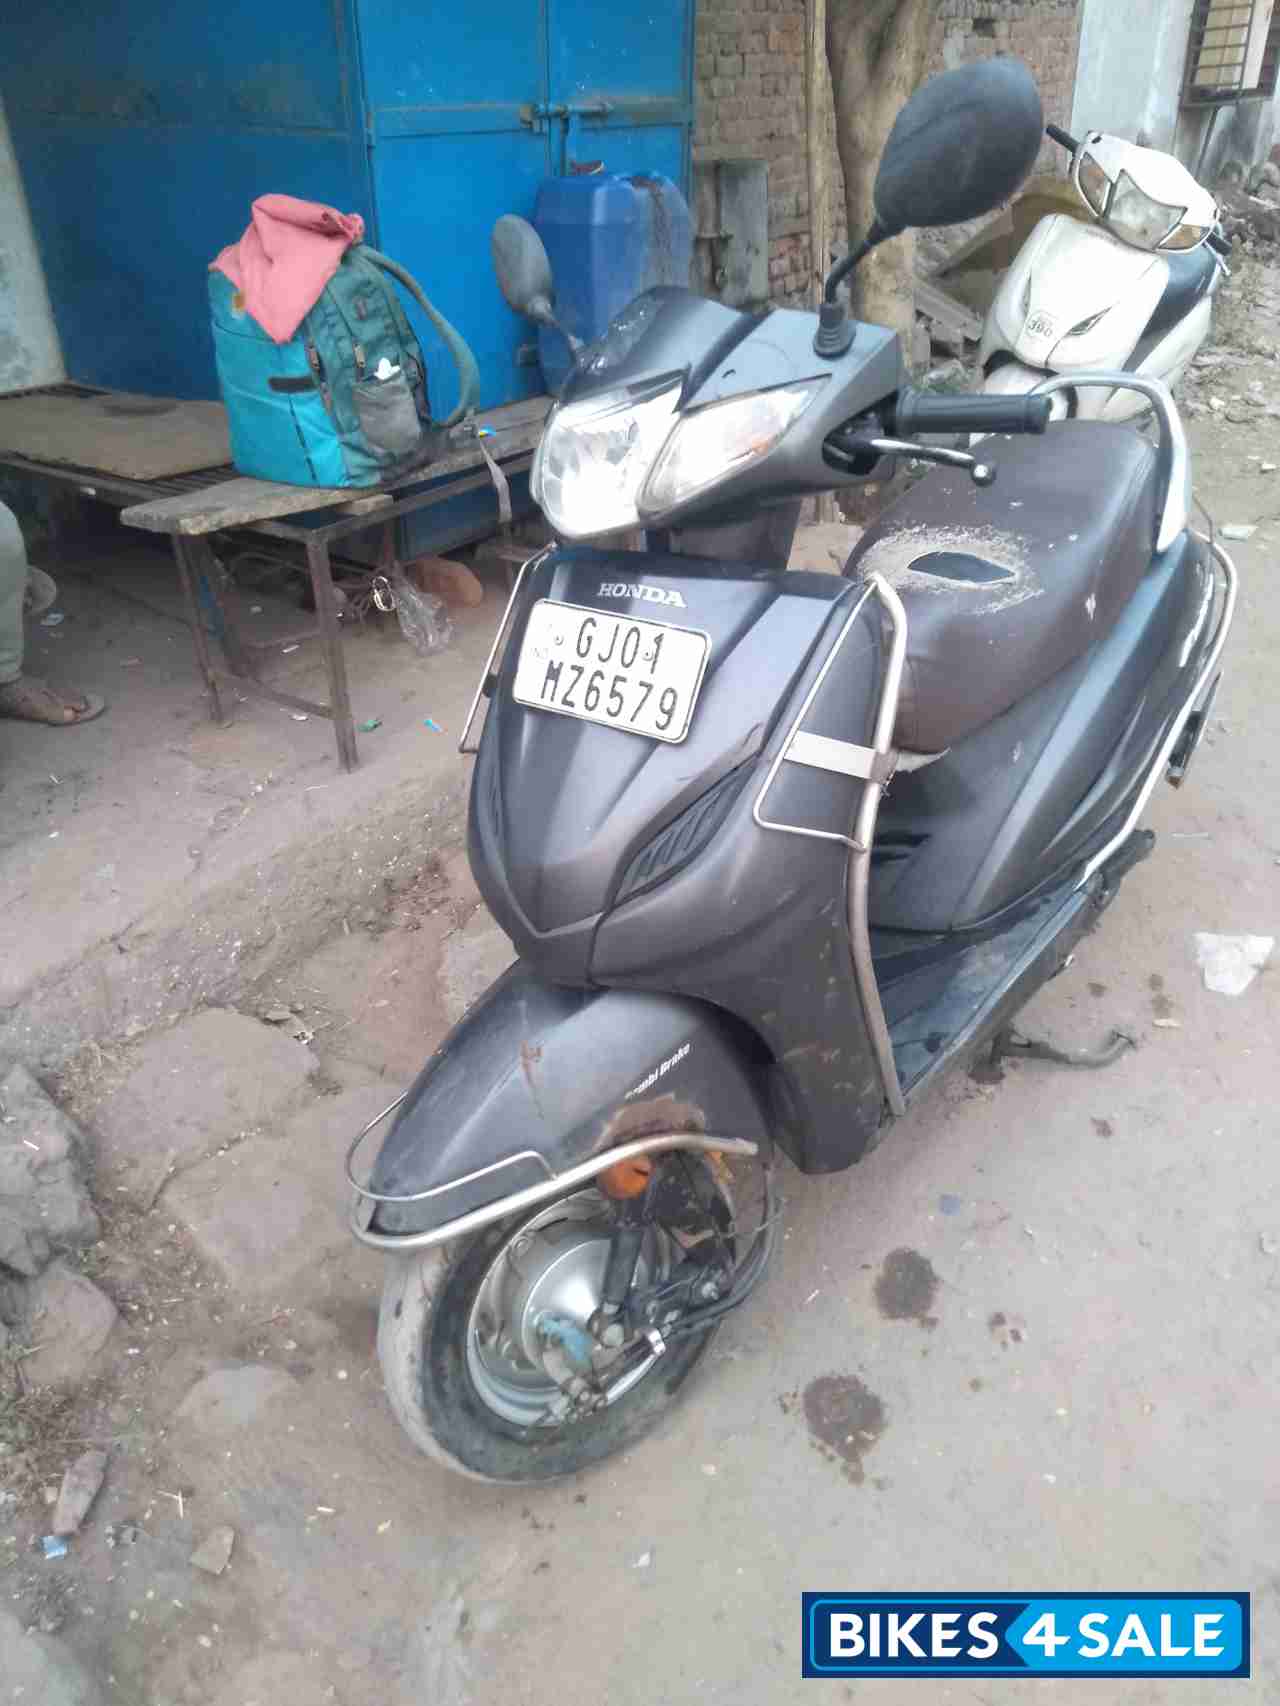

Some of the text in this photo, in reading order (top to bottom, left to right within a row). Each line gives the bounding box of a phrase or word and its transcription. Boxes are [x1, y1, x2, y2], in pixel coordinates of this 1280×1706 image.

[597, 583, 687, 608] HONDA
[576, 617, 664, 675] GJ01
[541, 659, 678, 731] MZ6579
